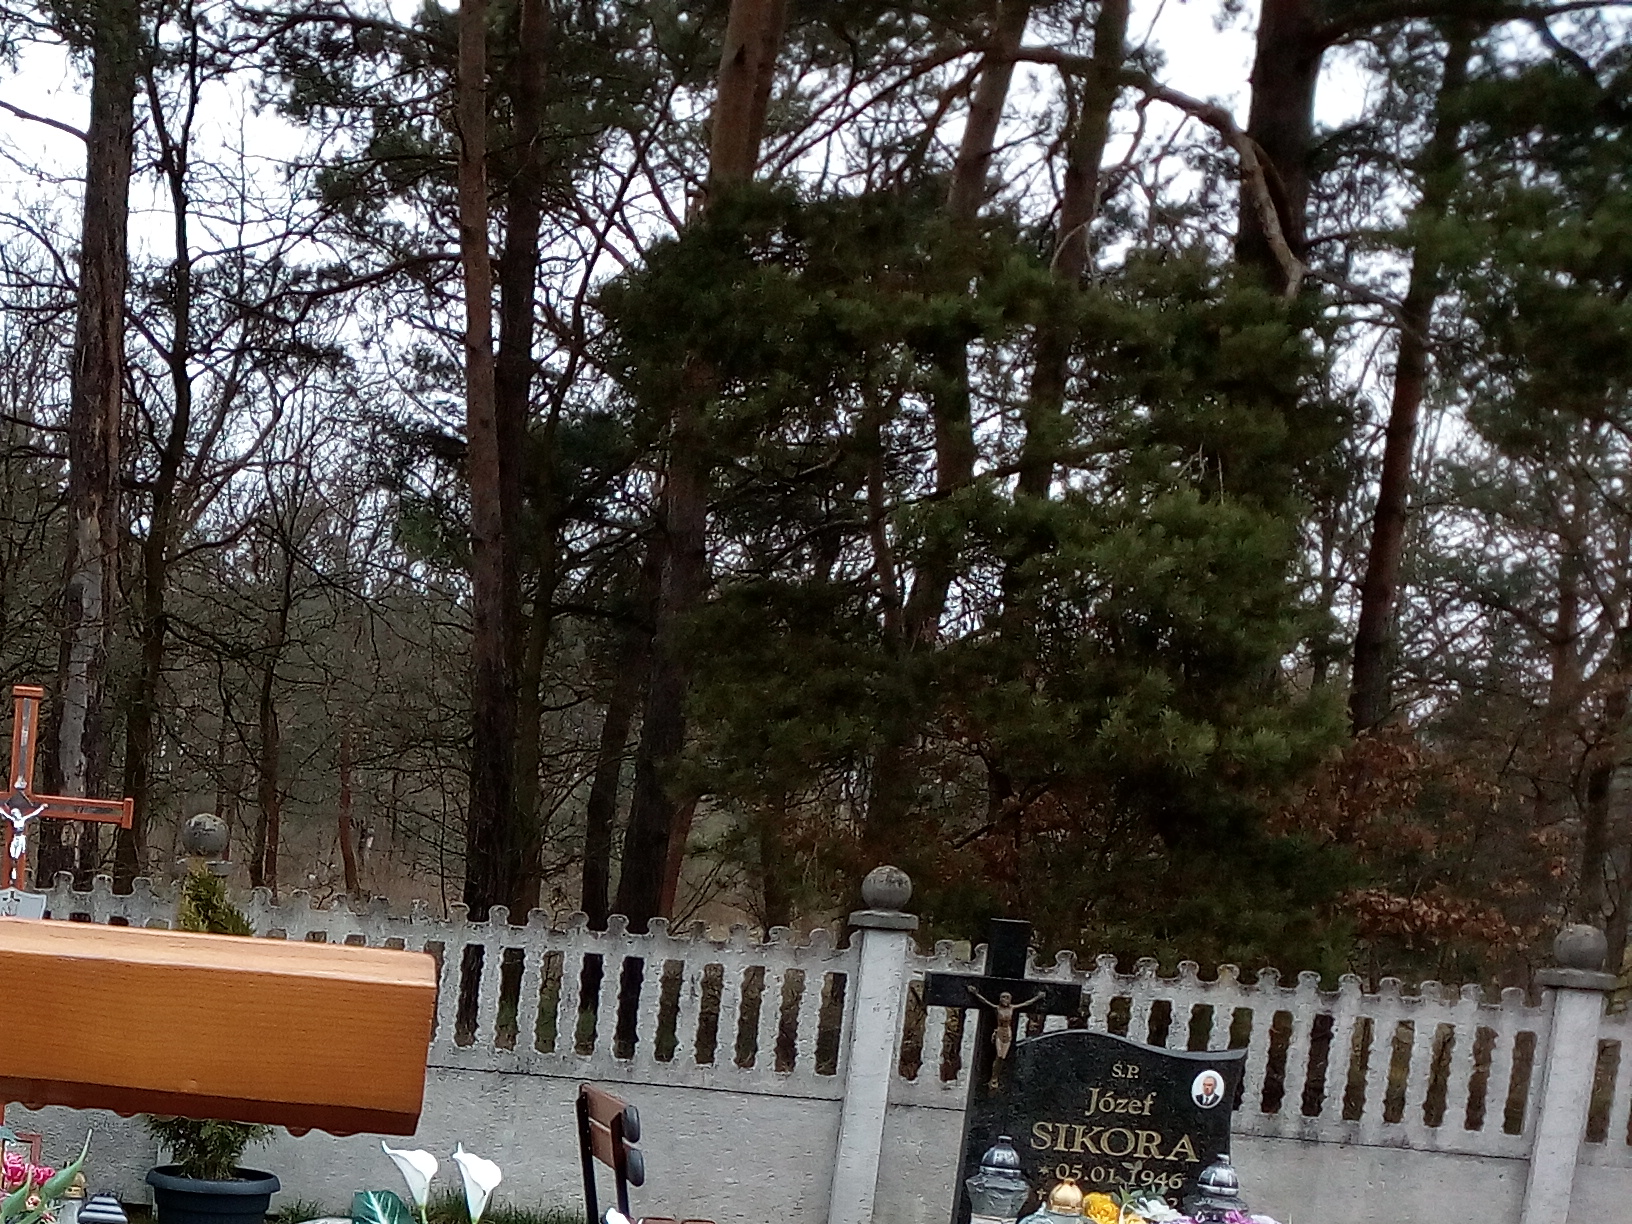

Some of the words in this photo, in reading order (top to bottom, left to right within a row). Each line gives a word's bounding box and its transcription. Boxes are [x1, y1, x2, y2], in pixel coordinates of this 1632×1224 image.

[1085, 1087, 1157, 1115] Józef
[1030, 1121, 1200, 1163] SIKORA
[1055, 1163, 1183, 1189] 05.011946
